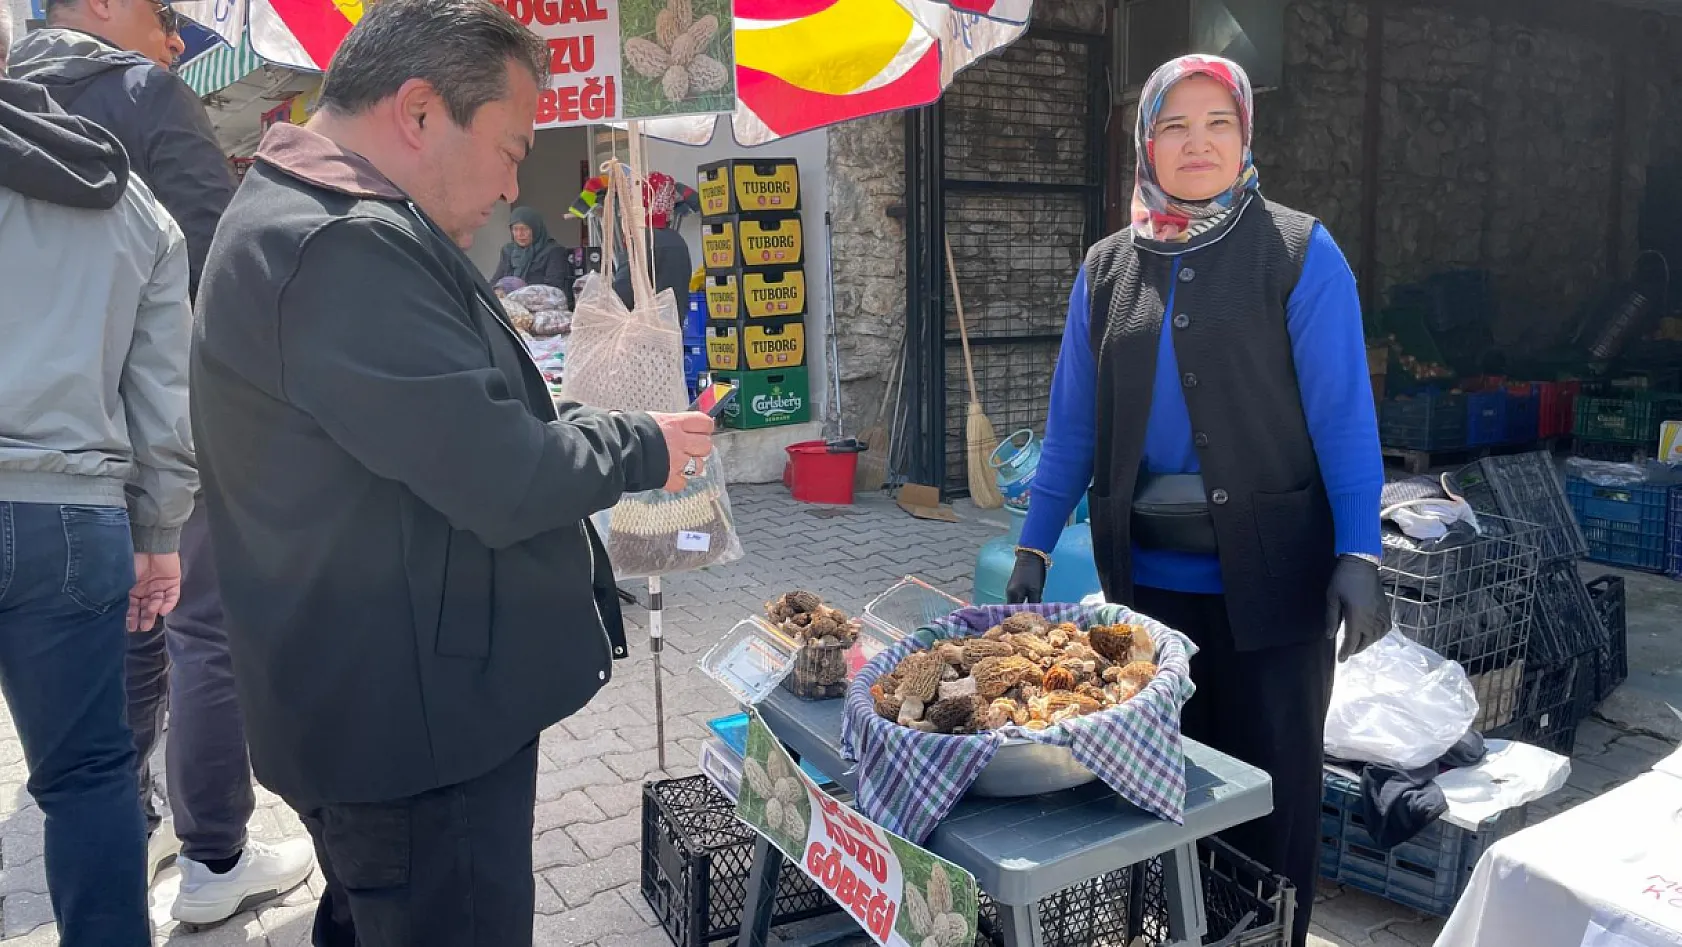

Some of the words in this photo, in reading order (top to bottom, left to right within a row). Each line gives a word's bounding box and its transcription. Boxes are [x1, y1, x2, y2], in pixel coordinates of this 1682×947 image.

[743, 180, 790, 195] TUBORG
[747, 235, 794, 249] TUBORG
[751, 286, 797, 302] TUBORG
[752, 339, 797, 354] TUBORG
[752, 391, 801, 417] Carlsberg
[822, 809, 888, 884] KUZU
